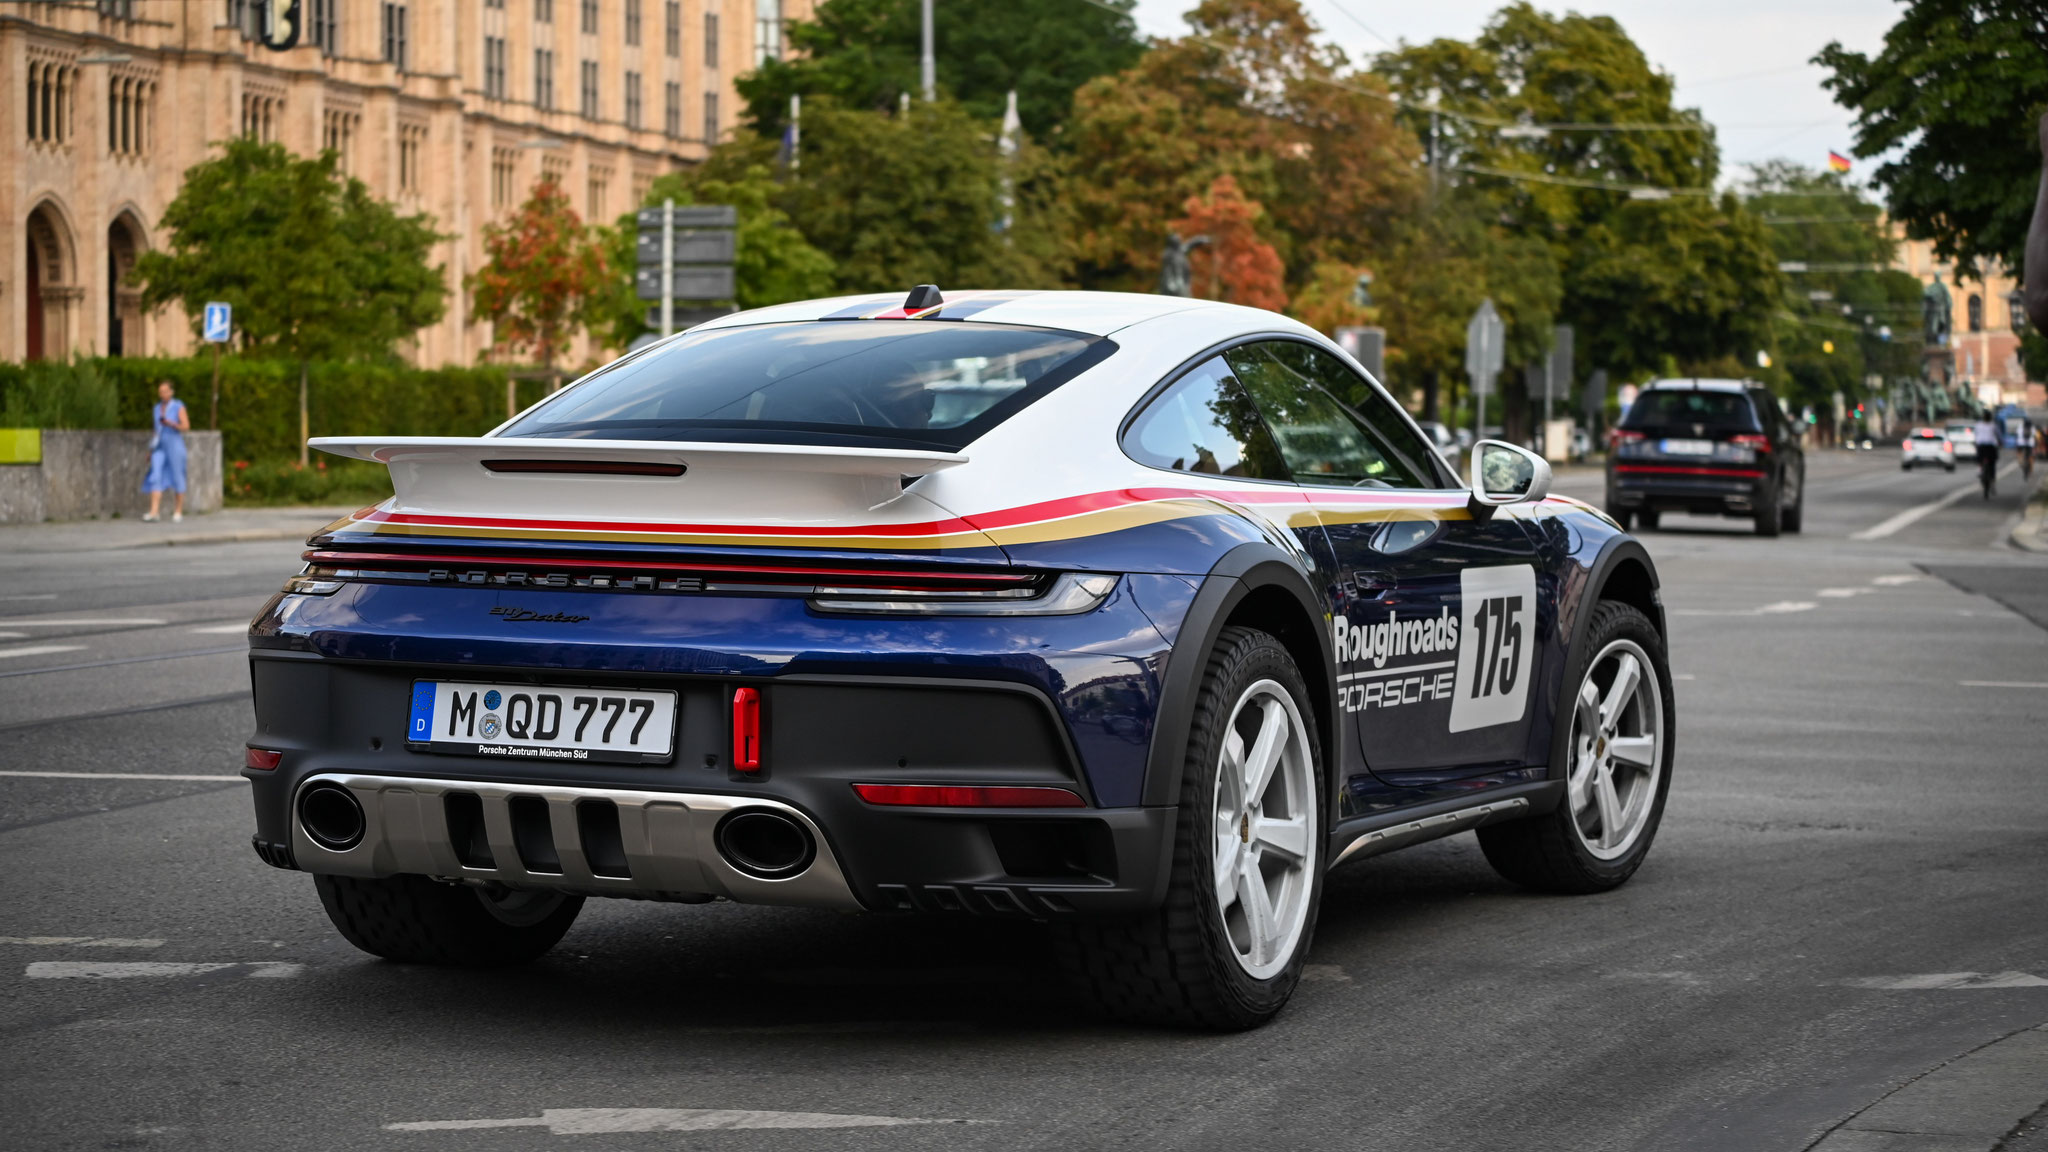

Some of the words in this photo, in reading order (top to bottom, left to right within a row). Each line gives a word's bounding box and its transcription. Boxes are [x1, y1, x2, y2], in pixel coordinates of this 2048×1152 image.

[428, 569, 703, 592] PORSCHE
[1334, 605, 1459, 669] Roughroads
[1471, 596, 1523, 699] 175
[416, 718, 426, 732] D
[572, 696, 655, 745] 777
[478, 745, 507, 755] Porsche
[508, 746, 538, 756] Zentrum
[539, 748, 572, 758] München
[573, 750, 588, 759] Süd
